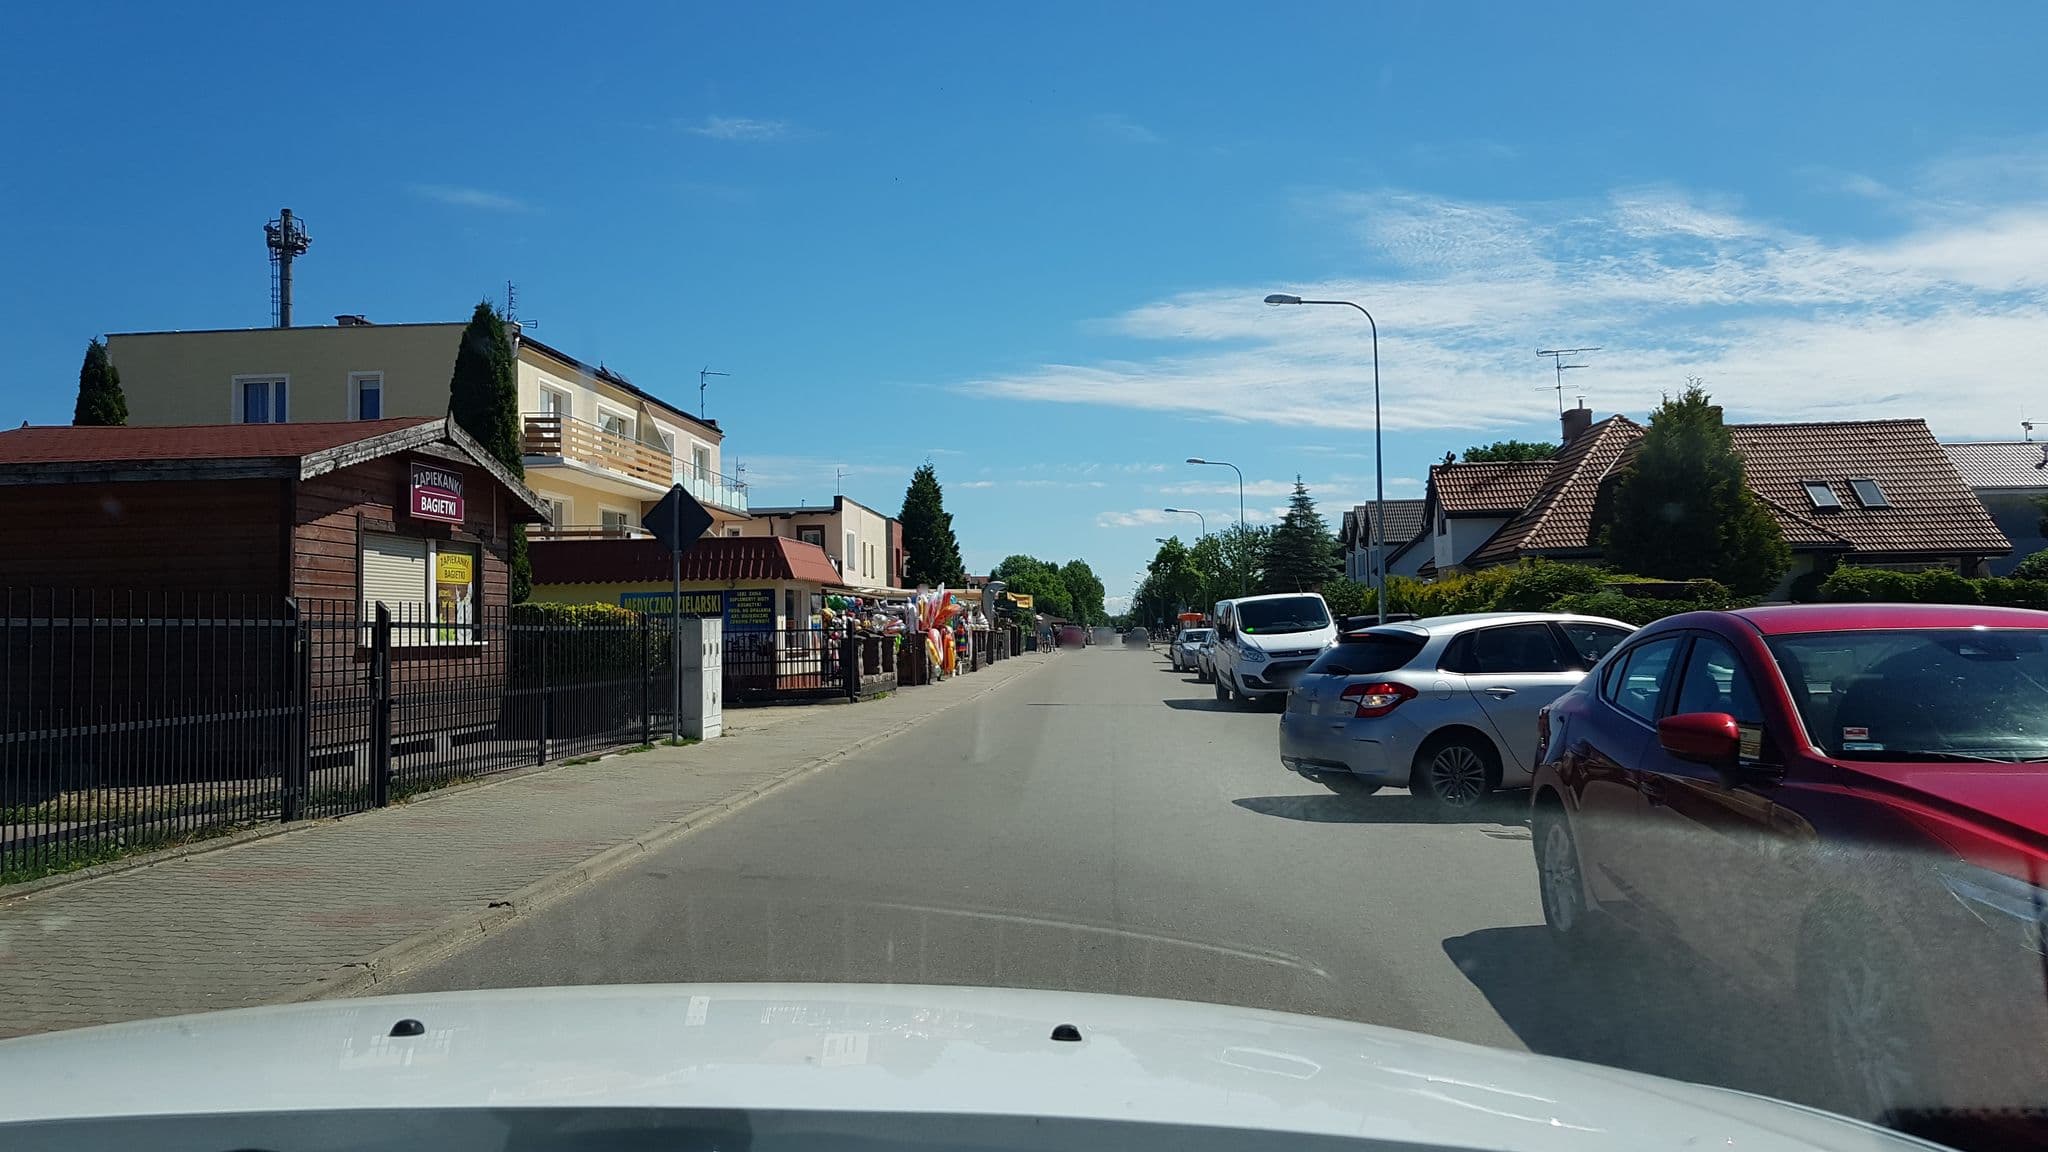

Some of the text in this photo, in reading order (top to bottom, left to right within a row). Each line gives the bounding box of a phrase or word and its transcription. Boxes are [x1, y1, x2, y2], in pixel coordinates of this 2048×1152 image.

[414, 471, 462, 497] ZAPIEKANKI
[421, 496, 456, 516] BAGIETKI
[444, 569, 466, 580] BAGIETKI
[624, 596, 673, 614] MEDYCZNO
